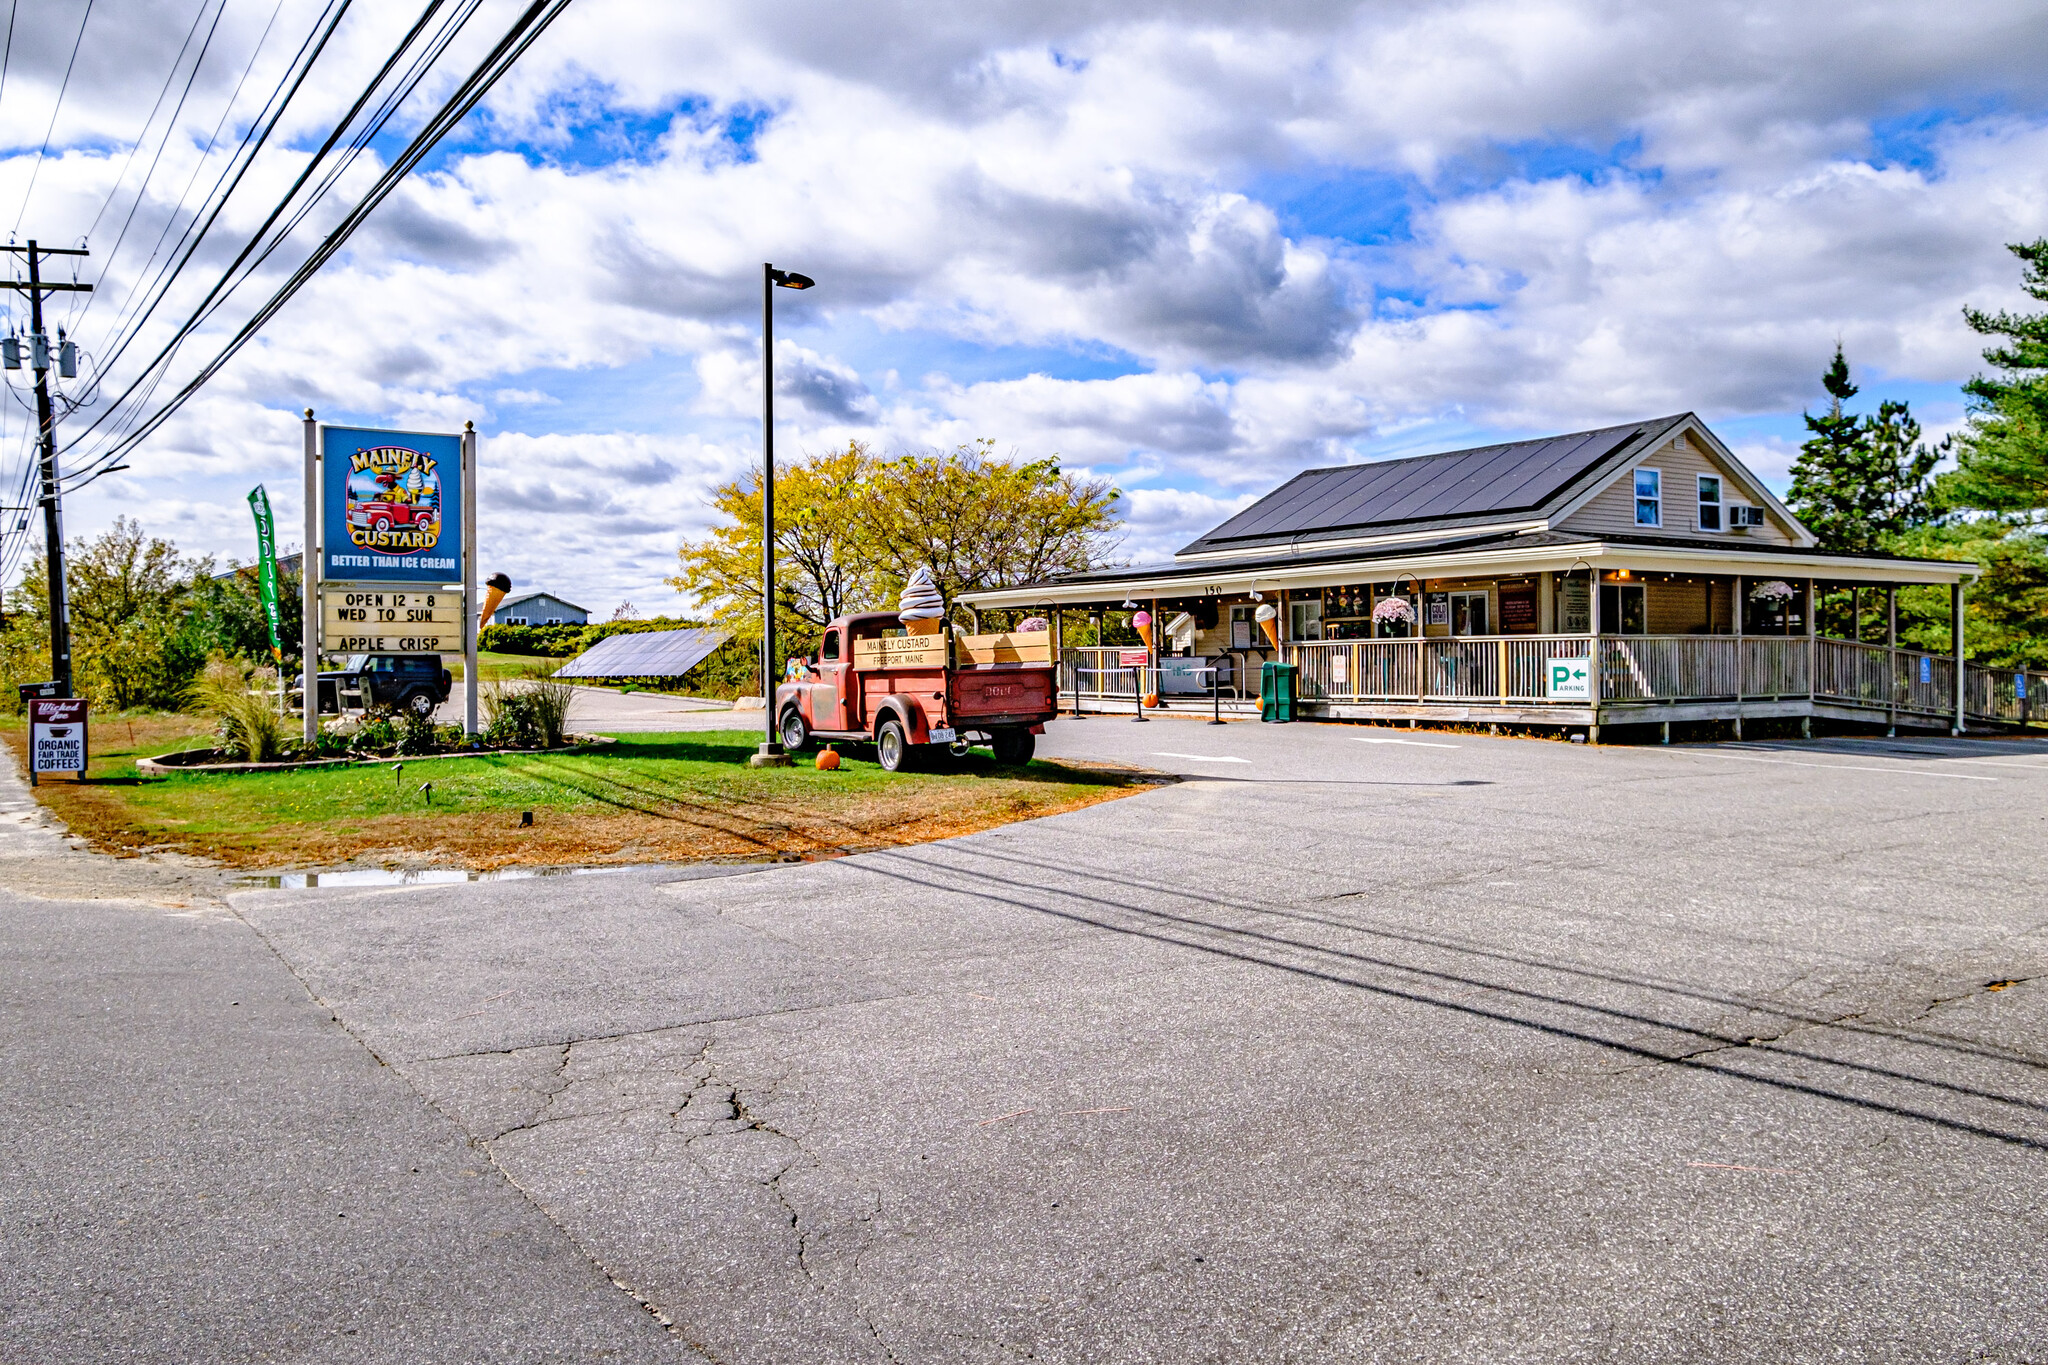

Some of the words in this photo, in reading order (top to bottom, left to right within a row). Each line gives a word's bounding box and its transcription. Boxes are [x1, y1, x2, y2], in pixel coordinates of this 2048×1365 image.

[350, 448, 438, 475] MAINELY
[350, 529, 438, 548] CUSTARD
[331, 554, 370, 567] BETTER
[372, 556, 400, 568] THAN
[402, 556, 418, 568] ICE
[420, 557, 455, 569] CREAM
[1204, 585, 1222, 596] 150
[345, 593, 383, 606] OPEN
[393, 595, 406, 606] 12
[427, 595, 435, 607] 8
[338, 608, 366, 621] WED
[377, 609, 396, 621] TO
[407, 609, 433, 622] SUN
[339, 637, 384, 651] APPLE
[399, 637, 439, 651] CRISP
[866, 640, 895, 651] MAINELY
[897, 637, 930, 649] CUSTARD
[873, 655, 904, 665] FREEPORT,
[905, 654, 924, 663] MAINE
[38, 702, 81, 712] Wicked
[49, 710, 69, 722] Joe
[38, 739, 80, 750] ORGANIC
[38, 750, 54, 759] FAIR
[56, 750, 79, 759] TRADE
[38, 758, 80, 769] COFFEES
